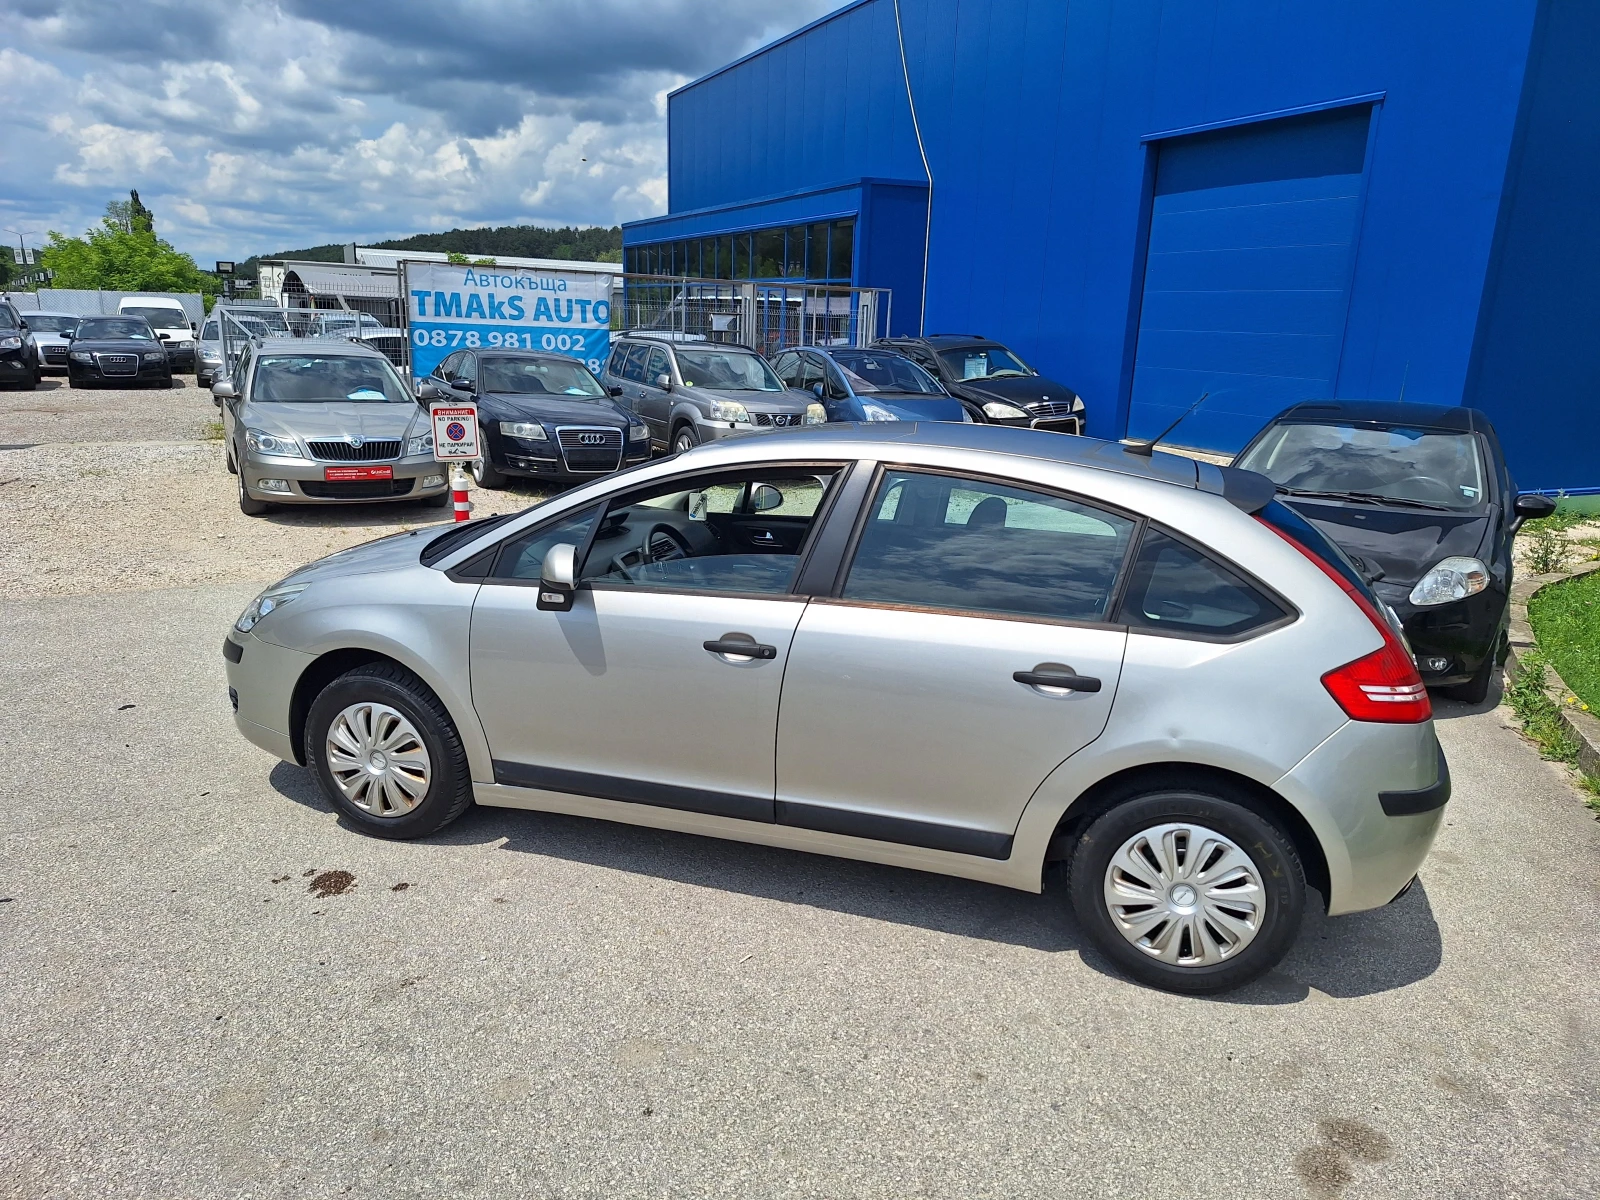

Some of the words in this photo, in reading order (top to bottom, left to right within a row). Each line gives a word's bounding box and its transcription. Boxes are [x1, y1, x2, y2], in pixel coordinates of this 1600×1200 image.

[463, 269, 568, 295] Автокъща
[410, 290, 525, 321] TMAkS
[533, 297, 610, 325] AUTO
[413, 329, 482, 349] 0878
[487, 331, 532, 350] 981
[541, 333, 586, 352] 002
